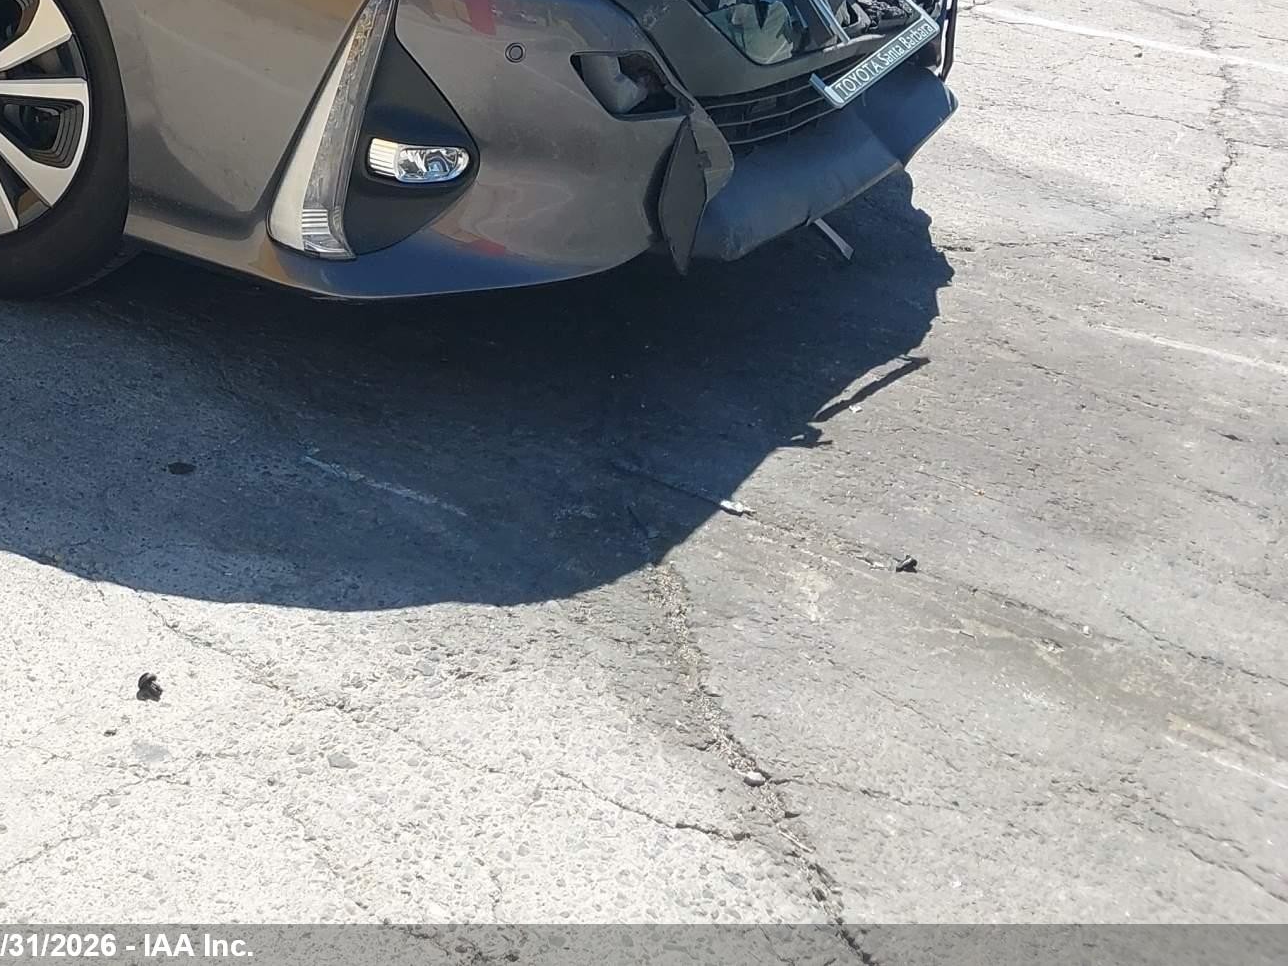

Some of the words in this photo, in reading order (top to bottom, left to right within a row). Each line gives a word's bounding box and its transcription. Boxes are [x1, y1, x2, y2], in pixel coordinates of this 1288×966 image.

[834, 59, 882, 98] TOYOTA
[878, 43, 905, 66] Santa
[900, 25, 934, 49] Barbara
